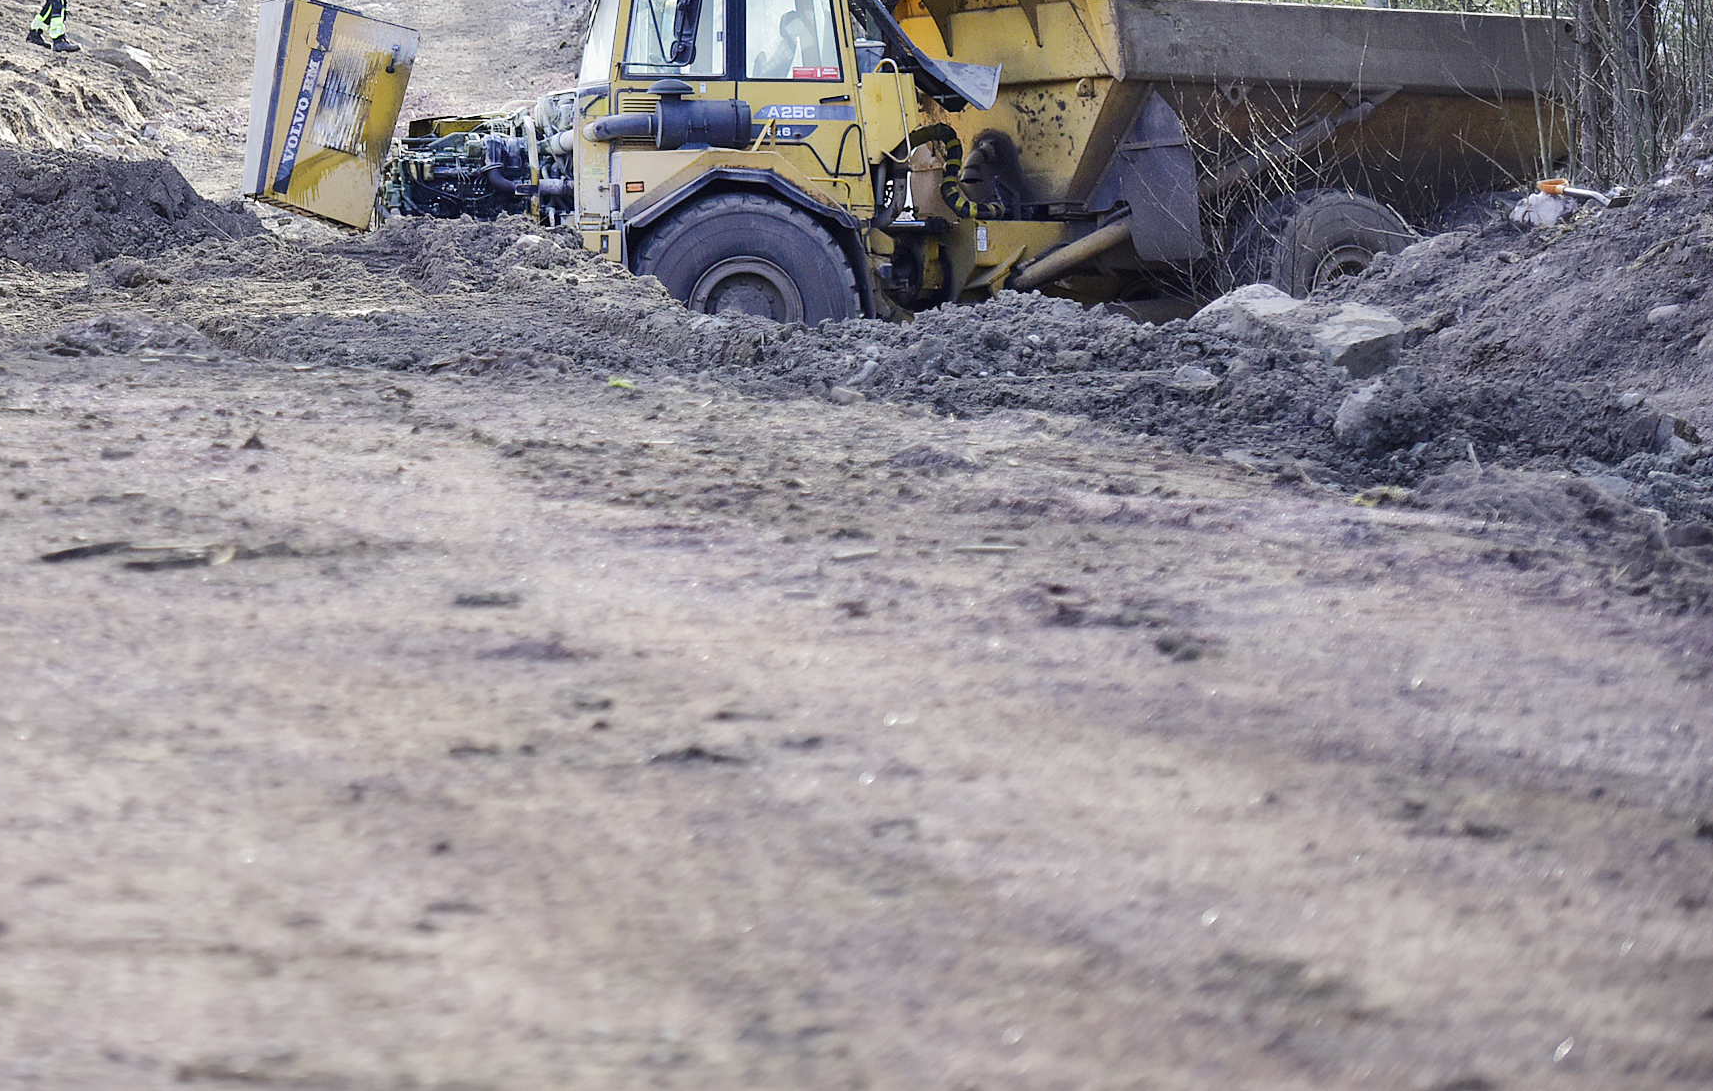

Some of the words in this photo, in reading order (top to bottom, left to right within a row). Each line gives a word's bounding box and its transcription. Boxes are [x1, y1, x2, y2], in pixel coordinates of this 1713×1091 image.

[282, 96, 309, 163] VOLVO
[302, 59, 321, 93] BM
[767, 106, 816, 119] A25C
